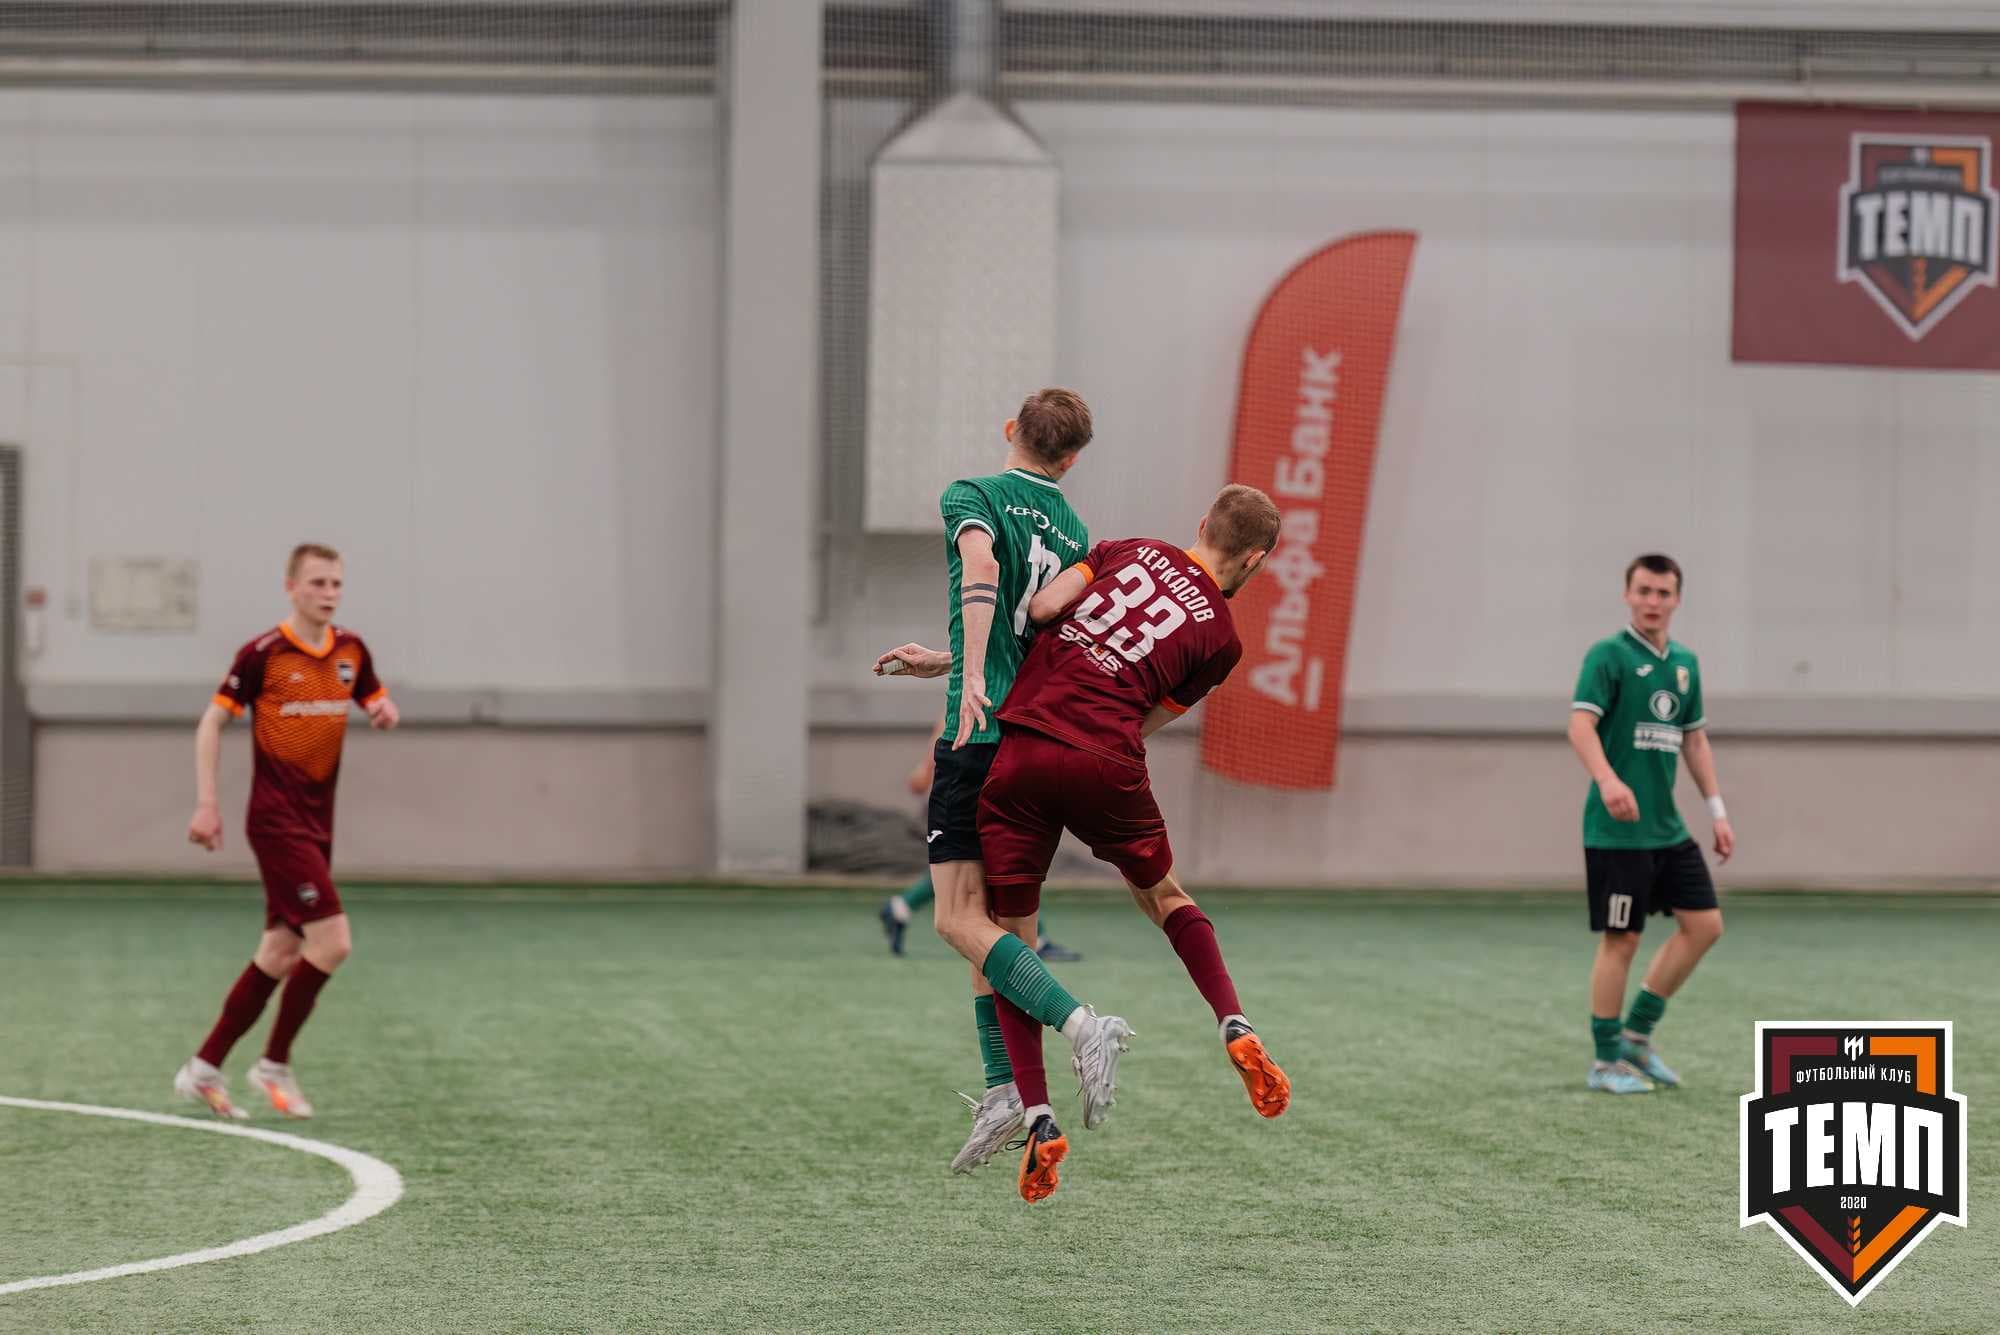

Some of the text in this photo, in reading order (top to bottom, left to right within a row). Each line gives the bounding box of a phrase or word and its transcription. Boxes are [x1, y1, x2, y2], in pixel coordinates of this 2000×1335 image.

[1855, 190, 1984, 265] ТЕМП
[1250, 347, 1343, 706] Альфа Банк
[1074, 563, 1187, 664] 33
[1137, 546, 1215, 623] ЧЕРКАСОВ
[1058, 624, 1123, 673] SEUS
[1608, 893, 1633, 929] 10
